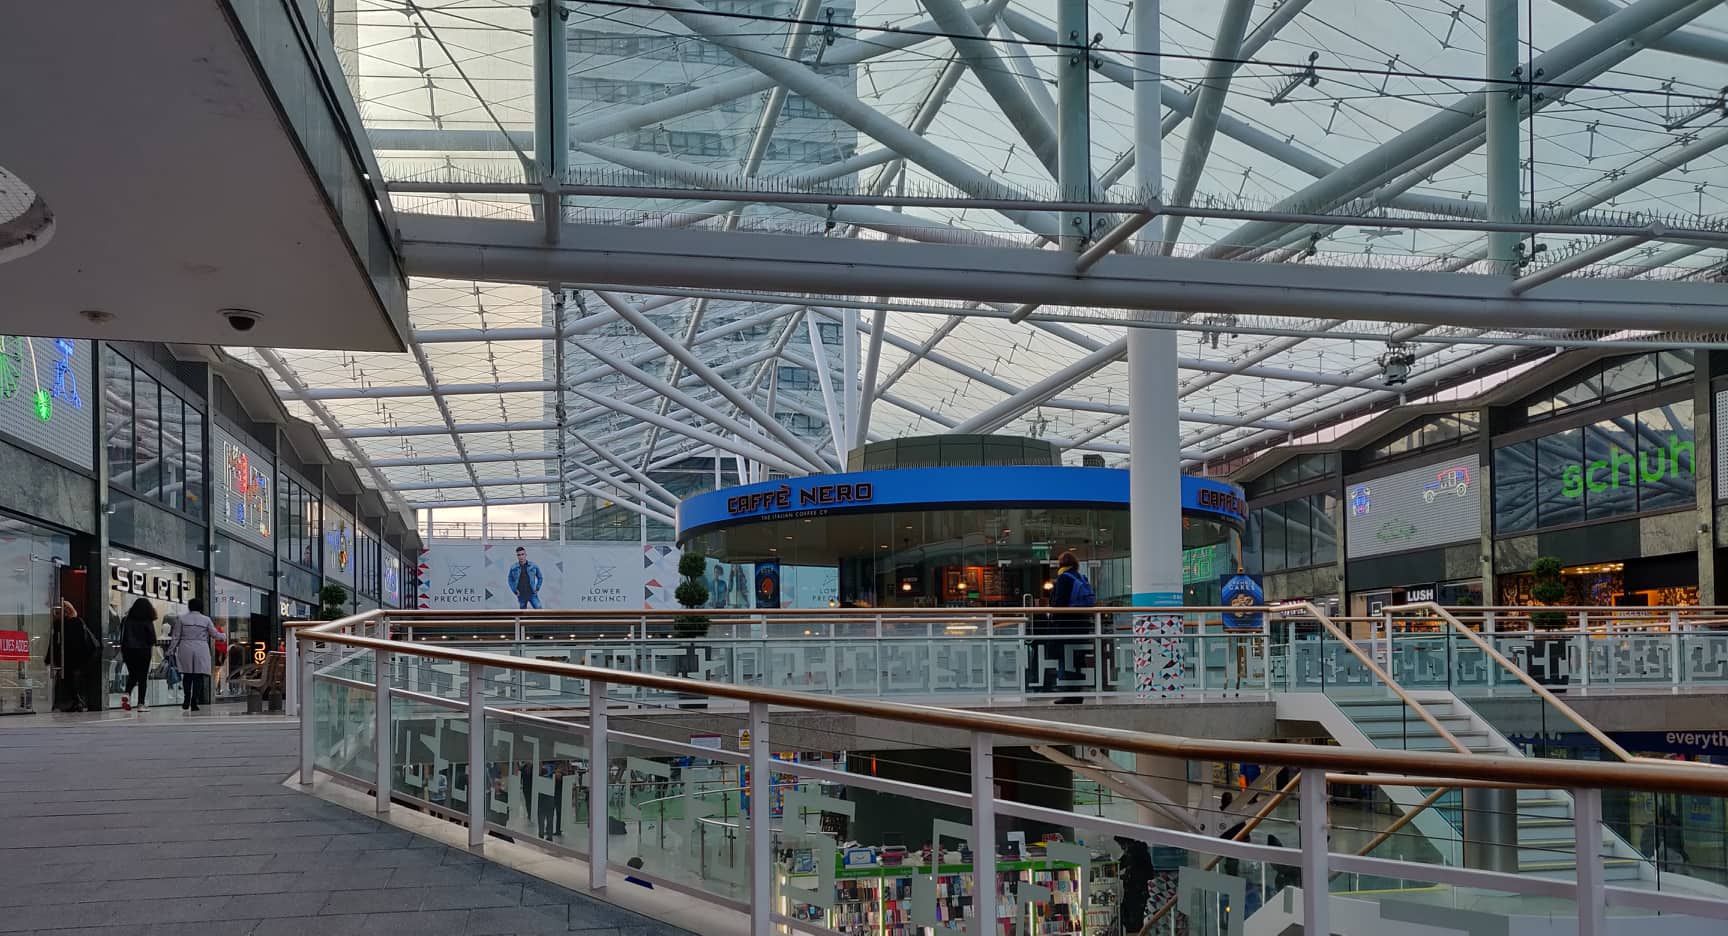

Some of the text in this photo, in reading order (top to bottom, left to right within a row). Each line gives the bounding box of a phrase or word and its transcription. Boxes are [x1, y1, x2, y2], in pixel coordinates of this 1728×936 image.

[1561, 435, 1696, 498] schuh
[728, 483, 873, 514] CAFFÈ NERO
[1407, 589, 1434, 602] LUSH
[1666, 731, 1728, 750] everyth
